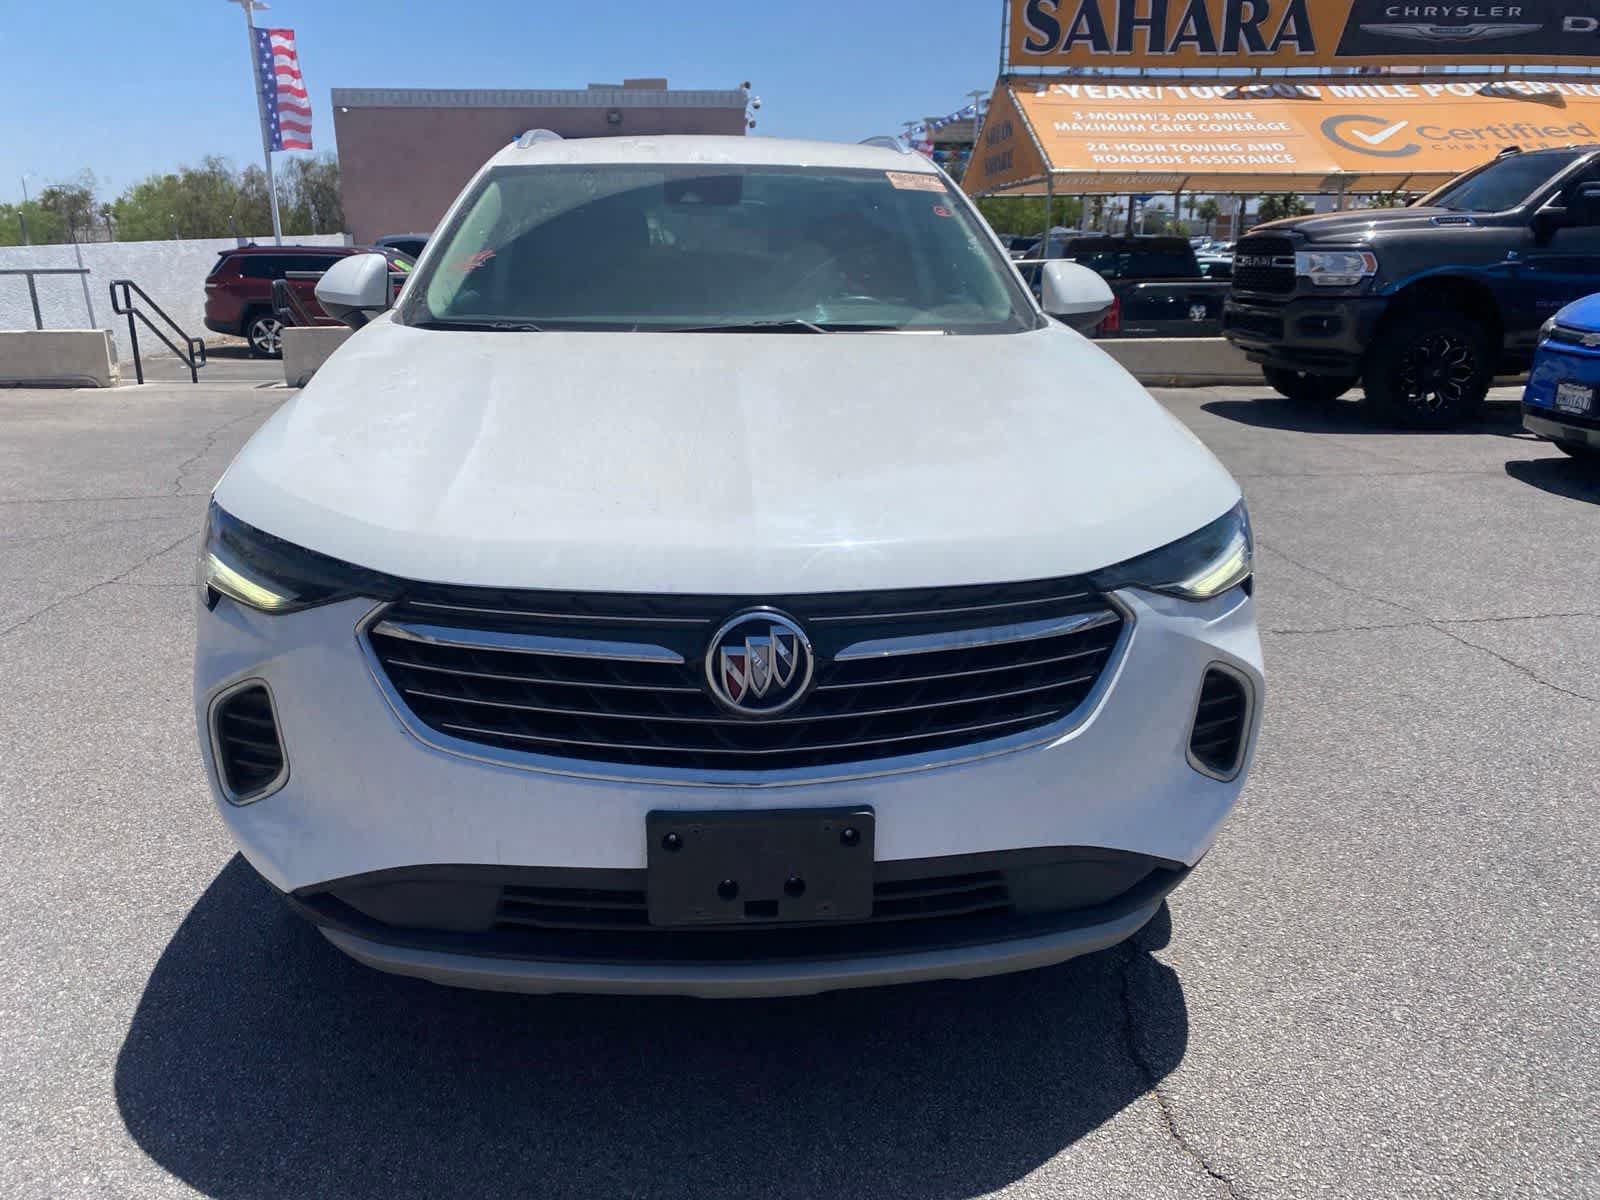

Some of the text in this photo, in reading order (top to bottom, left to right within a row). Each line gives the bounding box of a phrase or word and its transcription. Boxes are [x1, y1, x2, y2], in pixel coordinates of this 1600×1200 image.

[1386, 6, 1522, 17] CHRYSLER
[1021, 0, 1316, 55] SAHARA
[1328, 84, 1420, 99] MILE
[1054, 122, 1291, 132] MAXIMUM CARE COVERAGE
[1416, 121, 1597, 142] Certified
[1168, 143, 1243, 152] TOWING
[1247, 143, 1285, 152] AND
[1092, 153, 1297, 164] ROADSIDE ASSISTANCE
